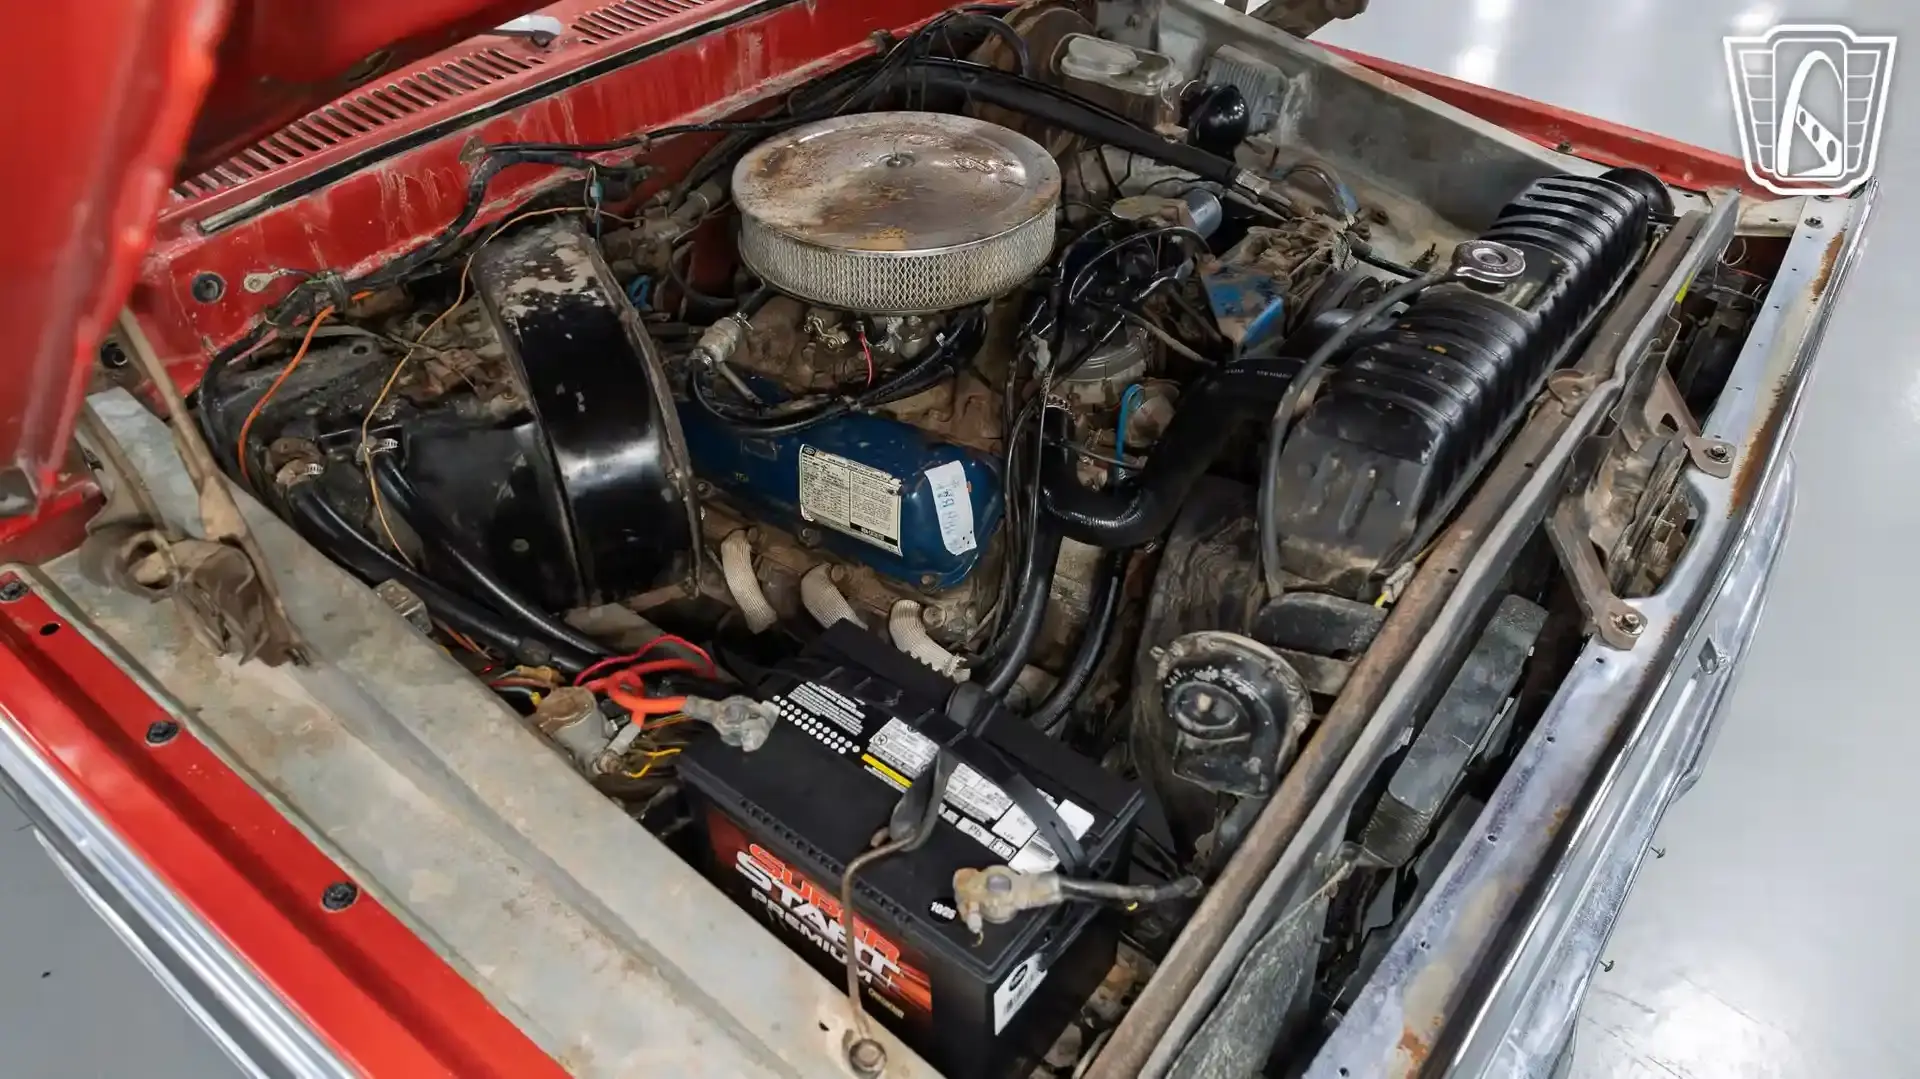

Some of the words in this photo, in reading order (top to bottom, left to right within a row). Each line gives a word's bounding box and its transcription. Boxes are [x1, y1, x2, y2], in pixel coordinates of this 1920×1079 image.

[736, 850, 903, 981] START
[749, 843, 900, 966] SUPER
[751, 887, 873, 985] PREMIUM
